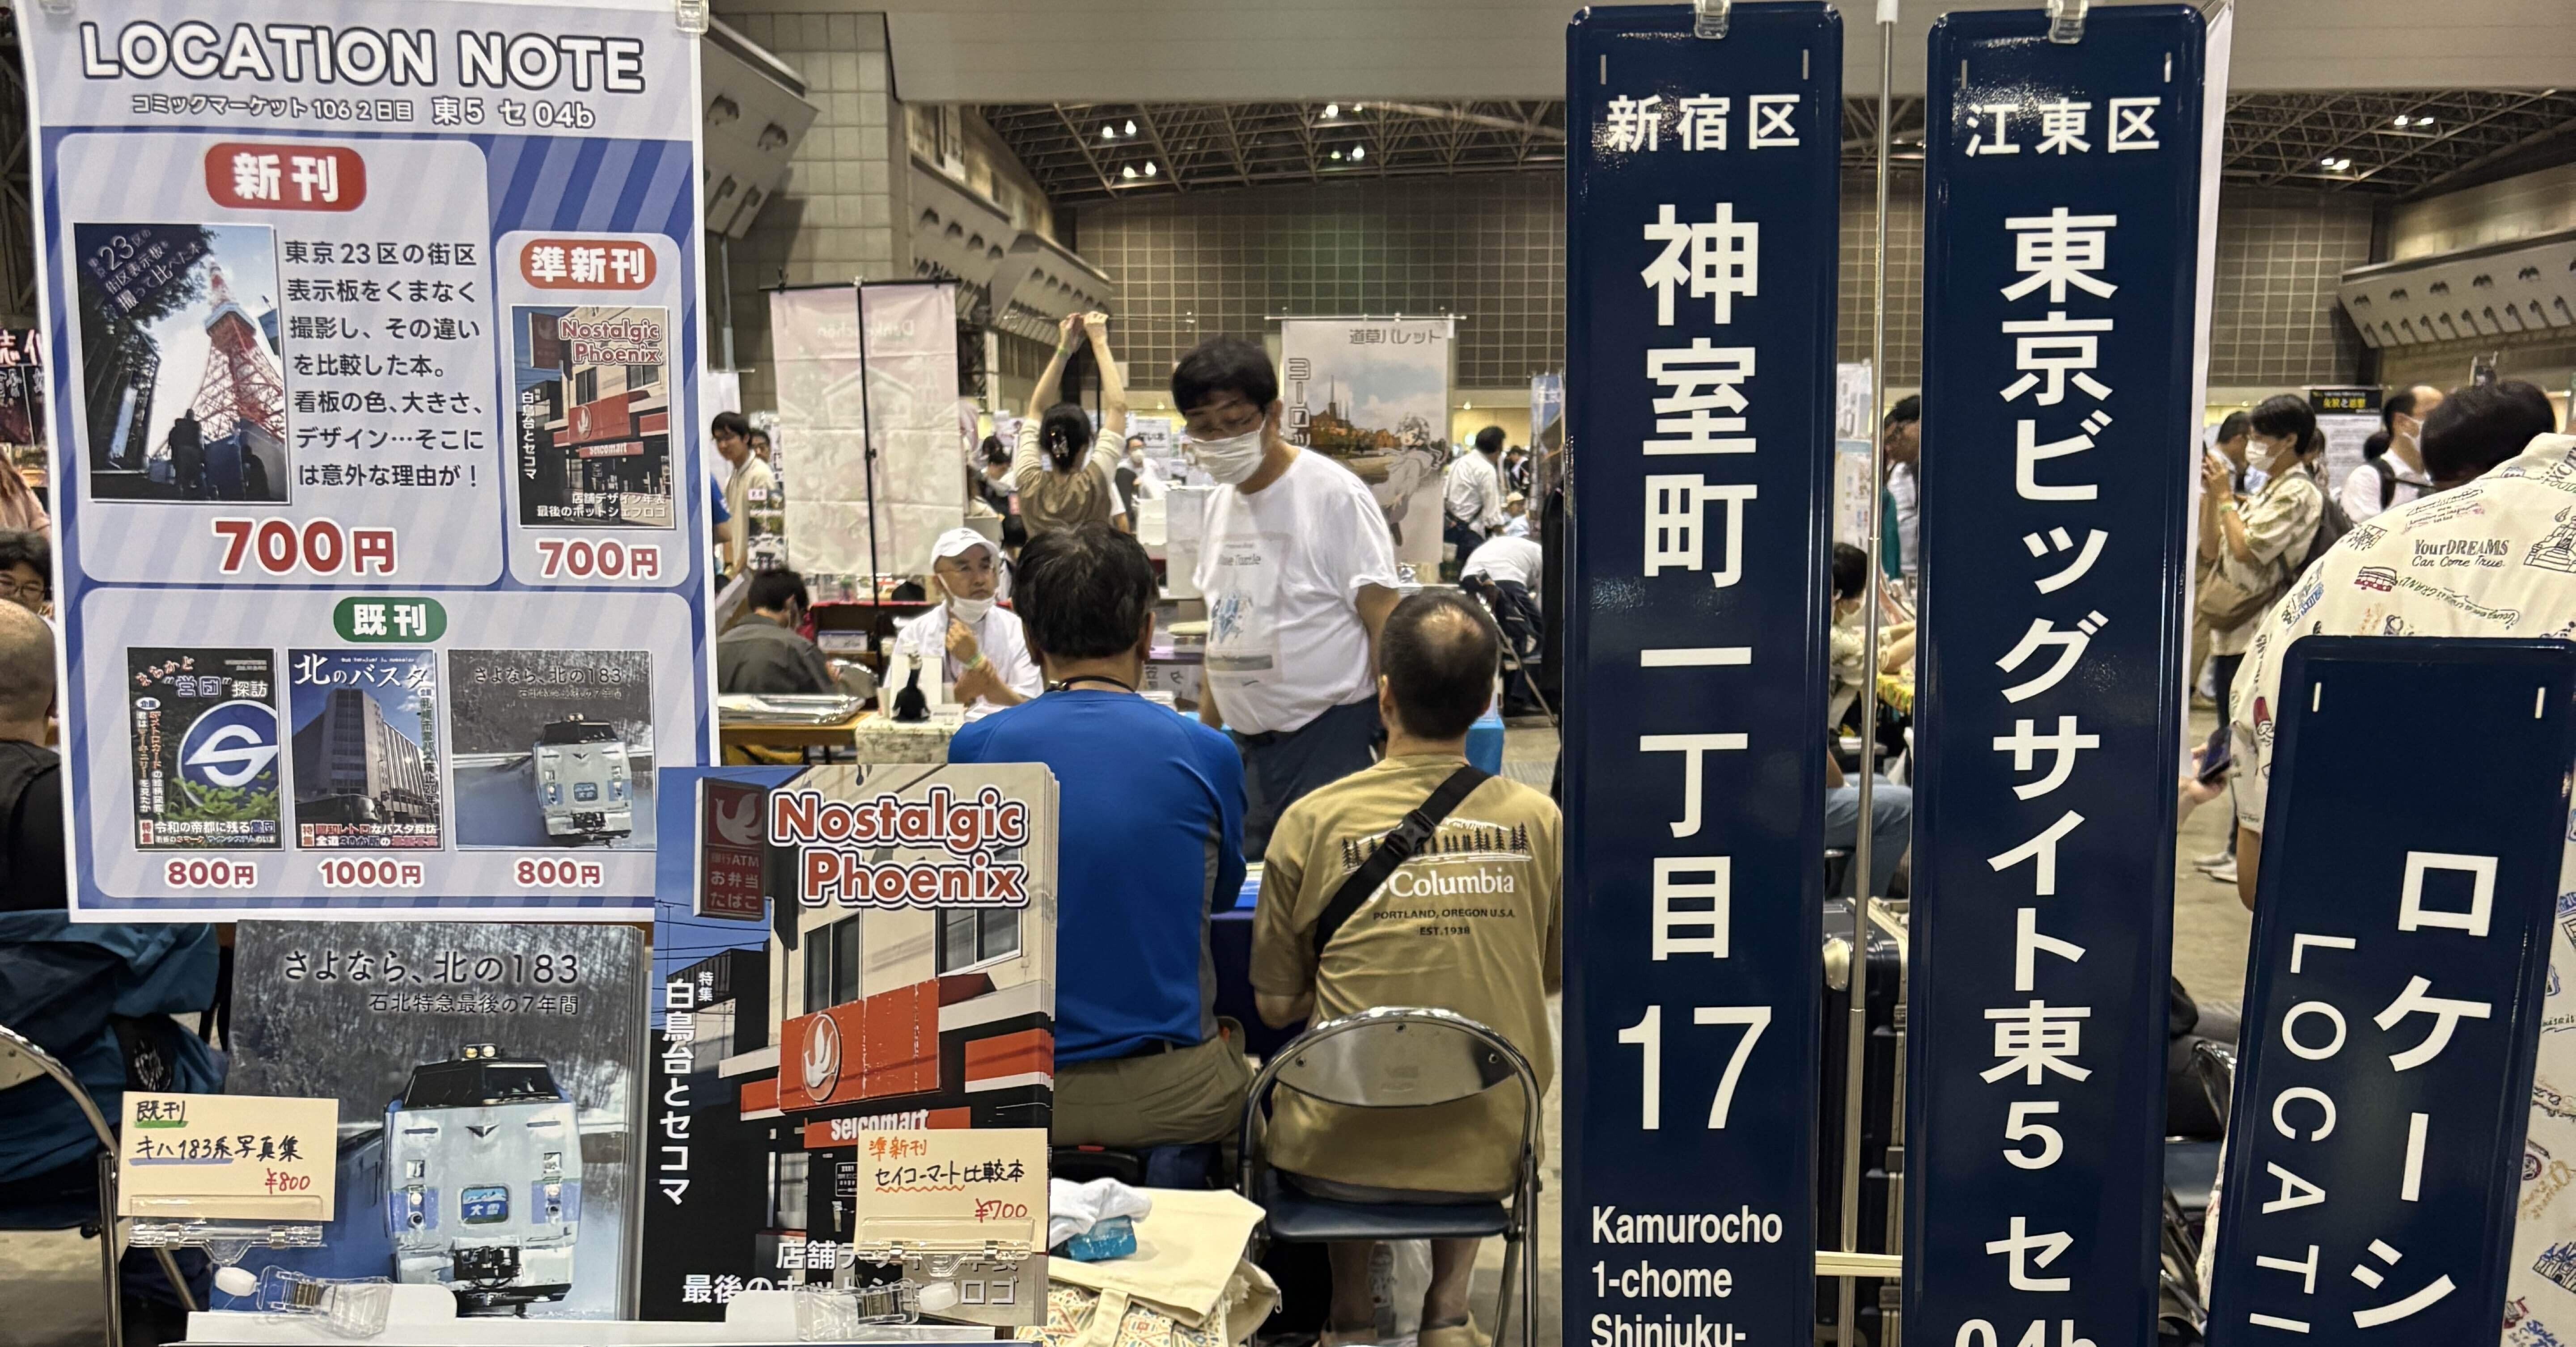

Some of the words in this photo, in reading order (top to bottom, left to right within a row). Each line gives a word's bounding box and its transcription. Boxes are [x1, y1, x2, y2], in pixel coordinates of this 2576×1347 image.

[80, 21, 437, 86] LOCATION
[457, 30, 645, 93] NOTE
[1607, 93, 1801, 152] 新宿区
[1966, 97, 2161, 157] 江東区
[233, 152, 340, 203] 新刊
[284, 240, 477, 267] 東京23区の街区
[531, 246, 646, 284] 準新刊
[288, 278, 476, 304] 表示板をくまなく
[290, 316, 480, 341] 撮影し、その違い
[559, 318, 661, 343] Nostalgic
[1349, 328, 1442, 346] 道草パレット
[294, 352, 445, 379] を比較した本。
[573, 341, 663, 366] Phoenix
[294, 390, 483, 416] 看板の色、大きさ、
[297, 427, 484, 451] デザイン…そこに
[213, 518, 396, 575] 700円
[538, 540, 659, 579] 700円
[1640, 203, 1758, 961] 神室町一丁目
[352, 604, 427, 637] 既刊
[294, 653, 428, 690] 北のバスタ
[475, 666, 622, 684] さよなら、北の183
[769, 784, 1029, 853] Nostalgic
[168, 860, 255, 886] 800円
[320, 860, 421, 885] 1000円
[517, 861, 601, 886] 800円
[711, 871, 758, 889] お弁当
[800, 846, 1030, 908] Phoenix
[1389, 867, 1515, 898] Columbia
[710, 892, 758, 910] たばこ
[1373, 909, 1439, 921] PORTLAND,
[1441, 908, 1487, 917] OREGON
[285, 949, 579, 985] さよなら、北の183
[698, 971, 714, 1002] 特集
[369, 992, 580, 1016] 石北特急最後の7年間
[1618, 1005, 1772, 1130] 17
[659, 978, 695, 1206] 白鳥台とセコマ
[2351, 850, 2499, 1330] ロケーシ
[136, 1100, 186, 1124] 既刊
[136, 1135, 304, 1162] キハ183系写真集
[869, 1136, 927, 1162] 準新刊
[2249, 933, 2356, 1334] LOCATI
[265, 1168, 311, 1194] ¥800
[974, 1199, 1028, 1223] ¥700
[1592, 1205, 1783, 1244] Kamurocho
[1986, 1216, 2074, 1292] セ
[1591, 1260, 1733, 1298] 1-chome
[1590, 1313, 1747, 1347] Shinjuku-
